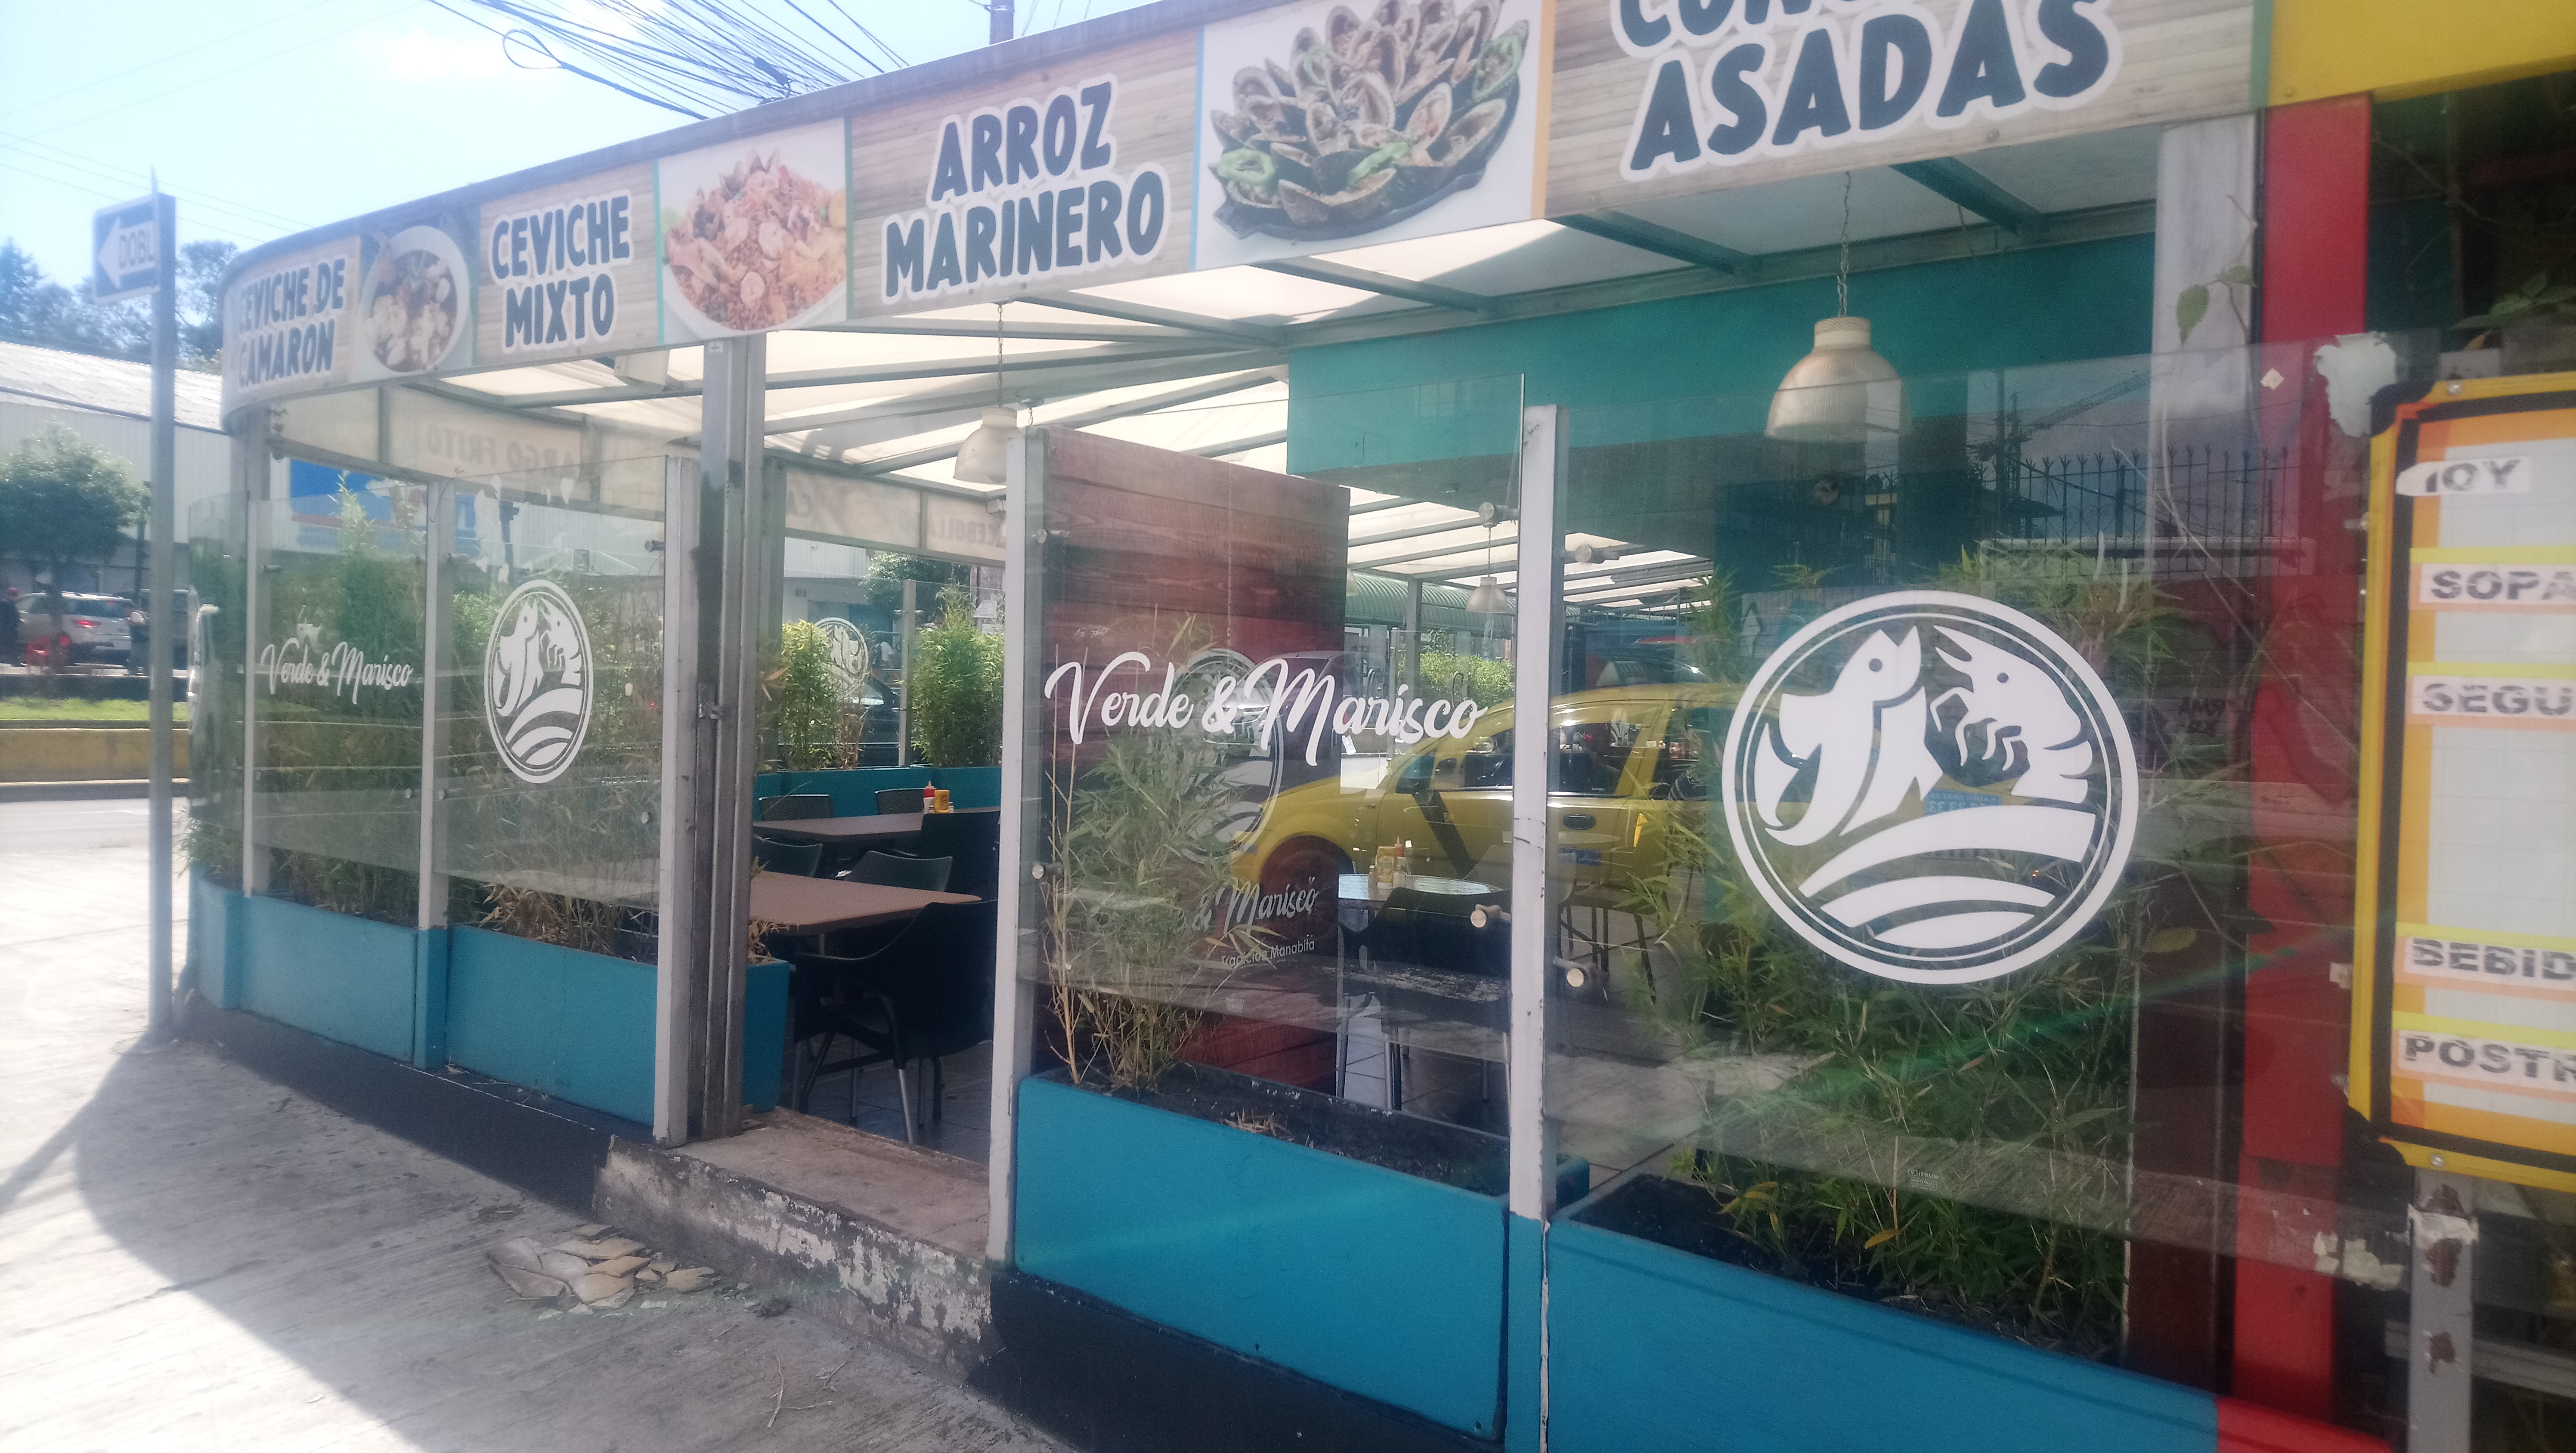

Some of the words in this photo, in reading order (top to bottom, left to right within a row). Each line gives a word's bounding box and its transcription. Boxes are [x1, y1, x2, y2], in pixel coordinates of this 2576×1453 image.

[1629, 0, 2110, 170] ASADAS
[931, 81, 1112, 201] ARROZ
[492, 195, 630, 280] CEVICHE
[885, 170, 1165, 297] MARINERO
[238, 267, 310, 334] CEVICHE
[314, 258, 346, 314] DE
[505, 273, 615, 347] MIXTO
[238, 318, 335, 388] CAMARON
[2431, 570, 2576, 600] SOPA
[260, 637, 313, 695] Verde
[316, 652, 330, 687] &
[331, 641, 414, 705] Marisco
[2422, 683, 2573, 715] SEGU
[1045, 651, 1193, 745] Verde
[1203, 676, 1237, 734] &
[1244, 658, 1488, 766] Marisco
[1215, 881, 1319, 937] Marisco
[1270, 937, 1315, 960] Manabita
